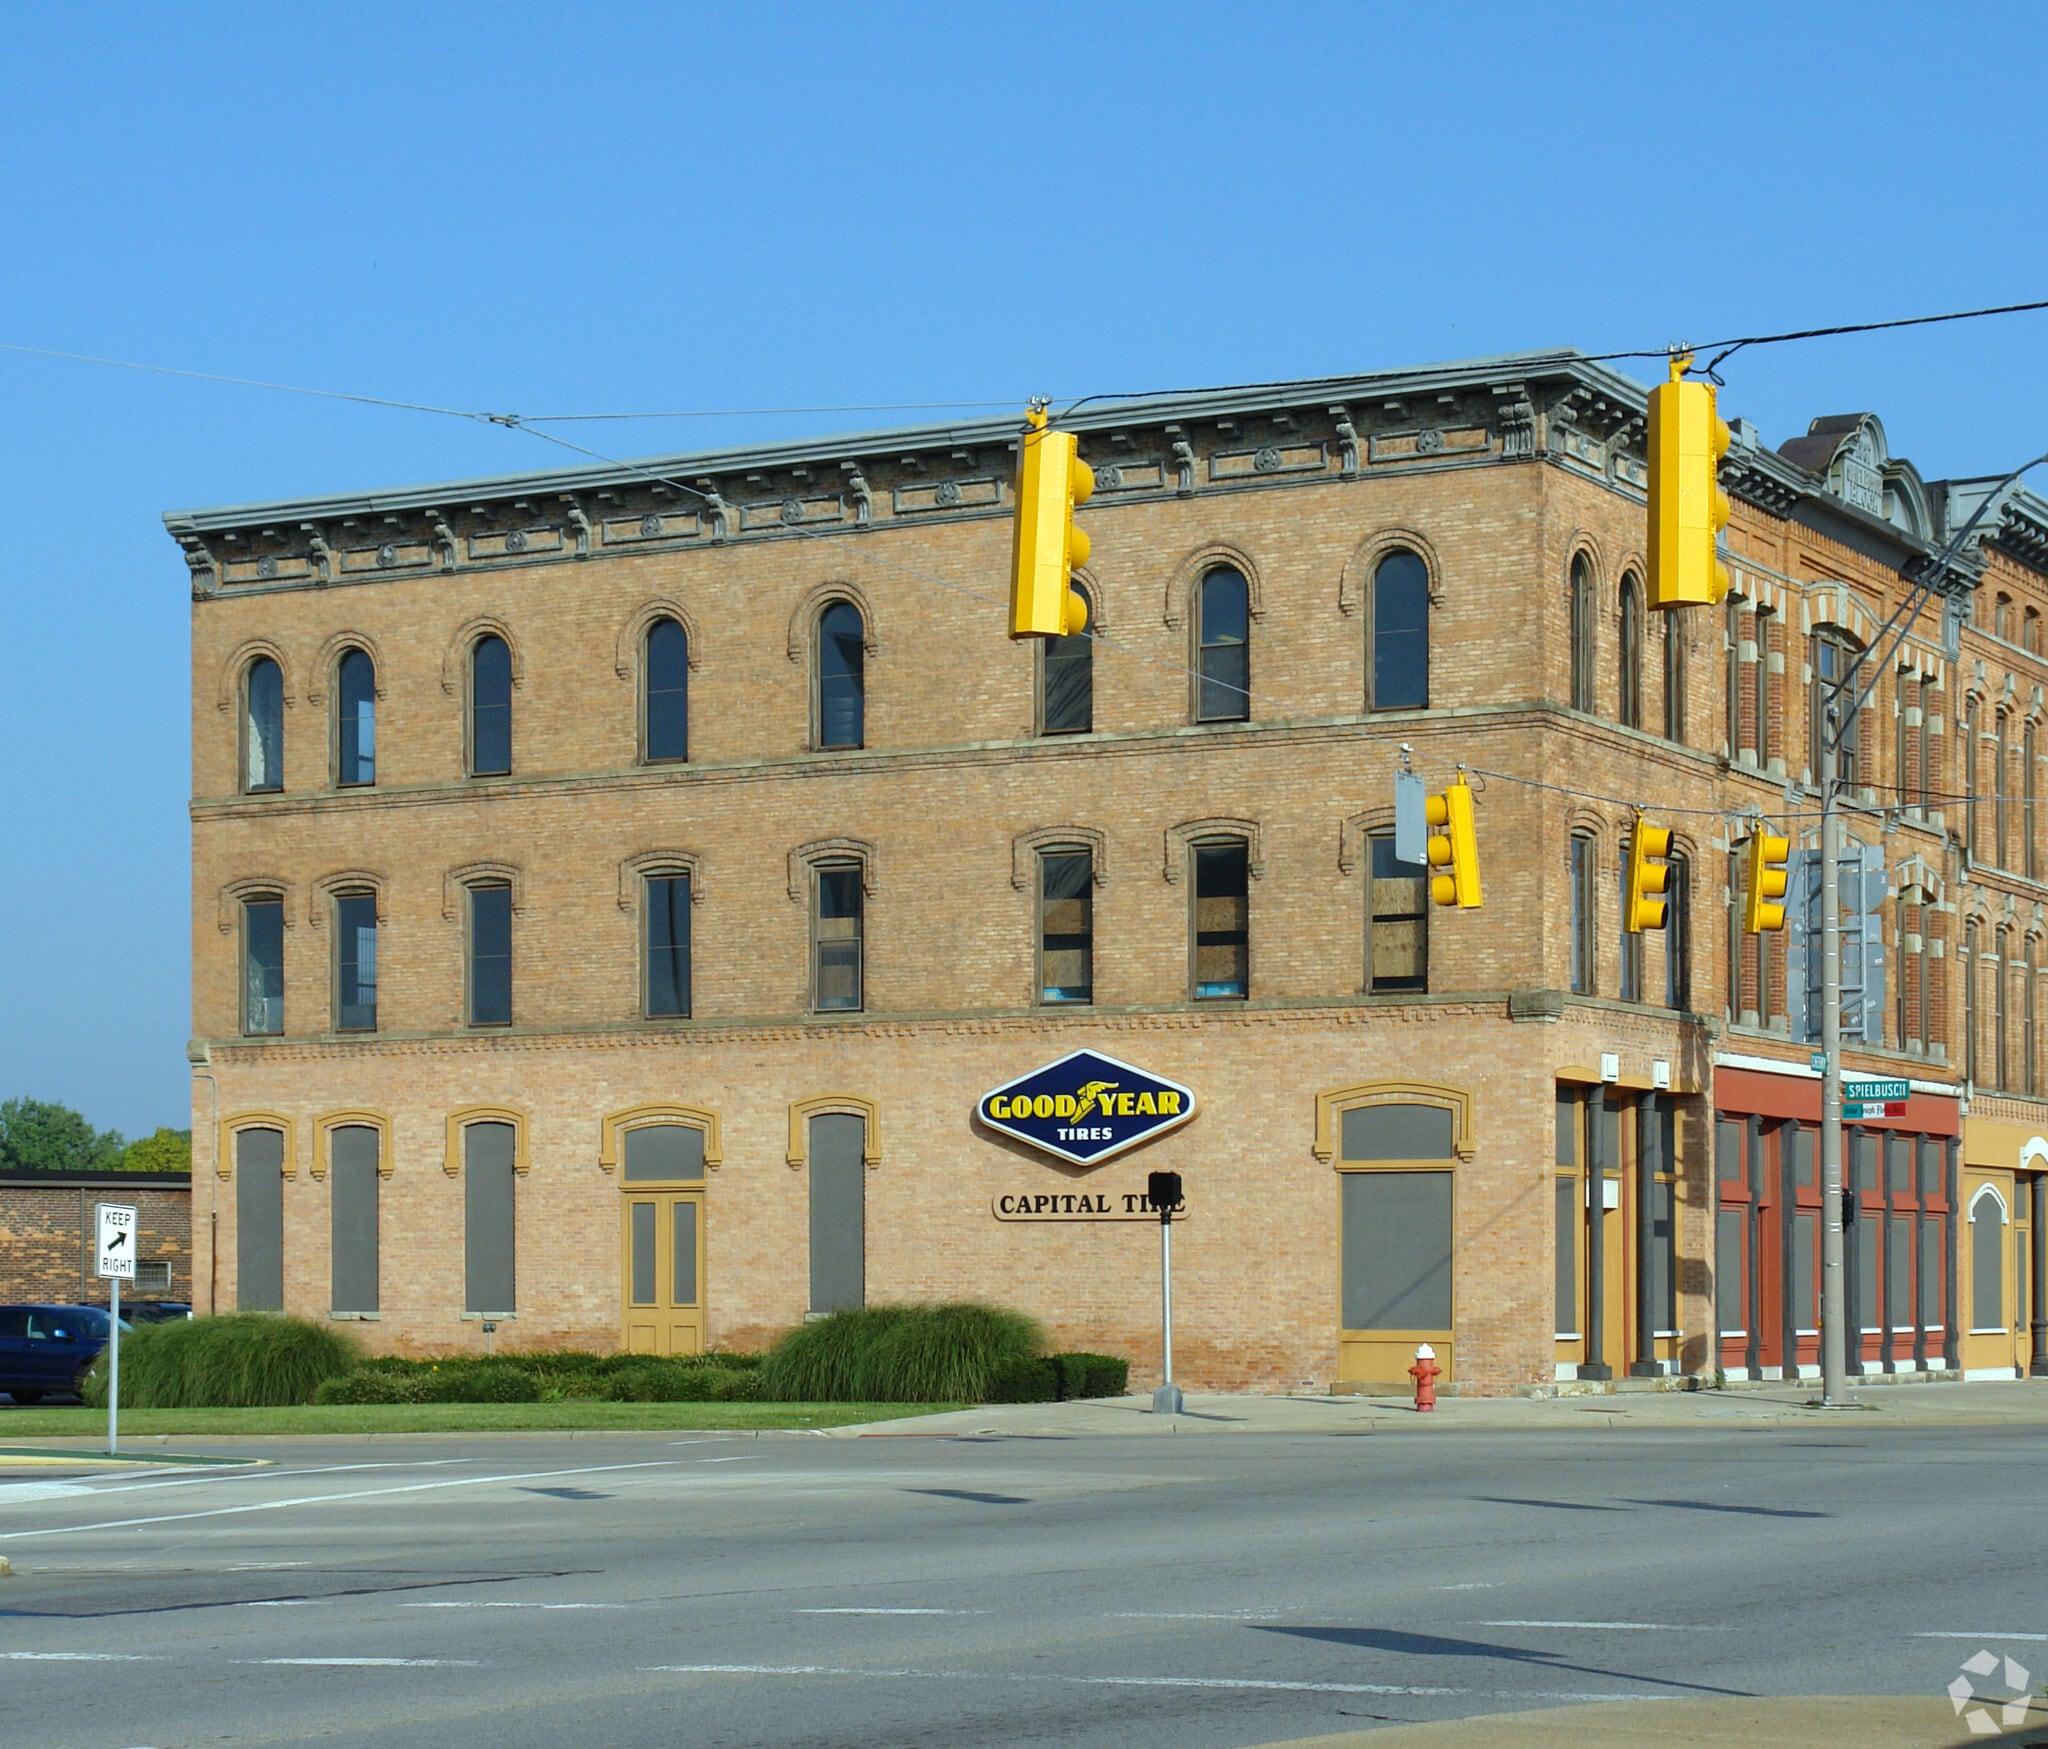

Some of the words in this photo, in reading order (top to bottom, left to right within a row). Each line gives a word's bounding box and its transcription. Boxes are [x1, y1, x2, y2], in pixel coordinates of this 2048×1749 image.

[1848, 1083, 1906, 1098] SPIELBUSCH
[1057, 1127, 1113, 1141] TIRES
[999, 1195, 1112, 1213] CAPITAL
[1121, 1194, 1186, 1213] TIE
[105, 1211, 131, 1226] KEEP
[102, 1257, 132, 1273] RIGHT
